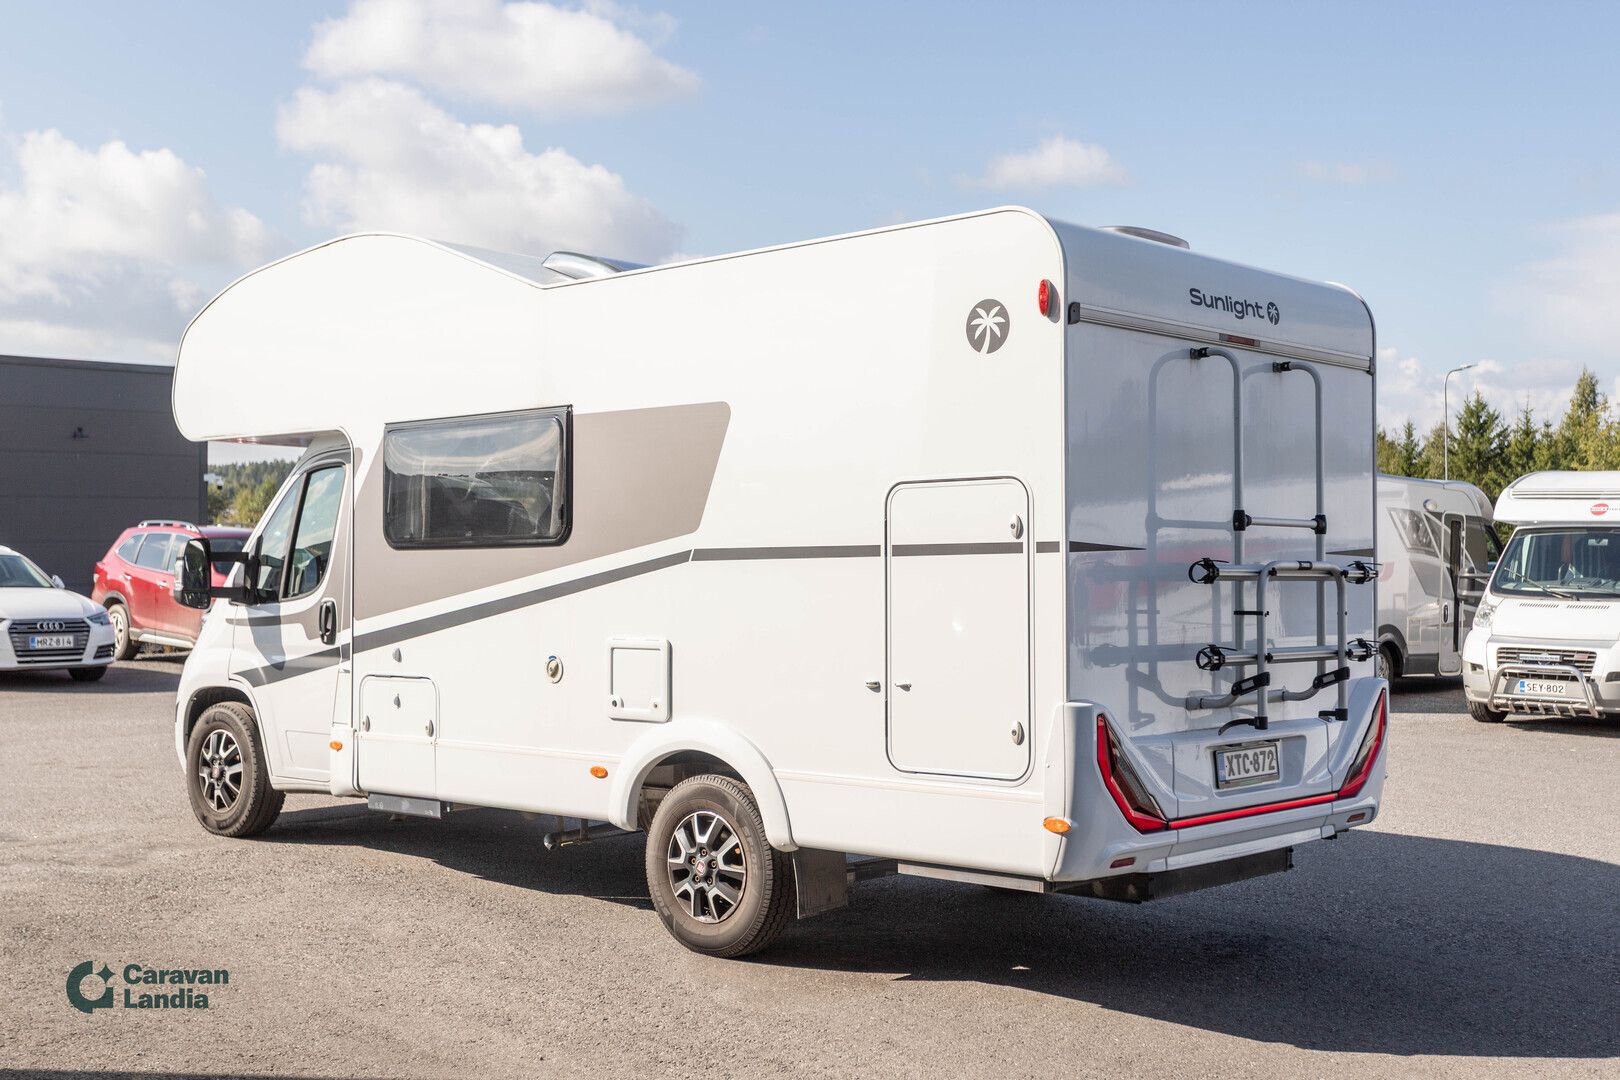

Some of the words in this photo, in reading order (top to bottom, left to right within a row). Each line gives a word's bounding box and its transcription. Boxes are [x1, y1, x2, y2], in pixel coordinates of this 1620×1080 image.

[1189, 287, 1264, 320] Sunlight
[1526, 683, 1564, 694] SEY-802
[1226, 749, 1276, 777] XTC-872
